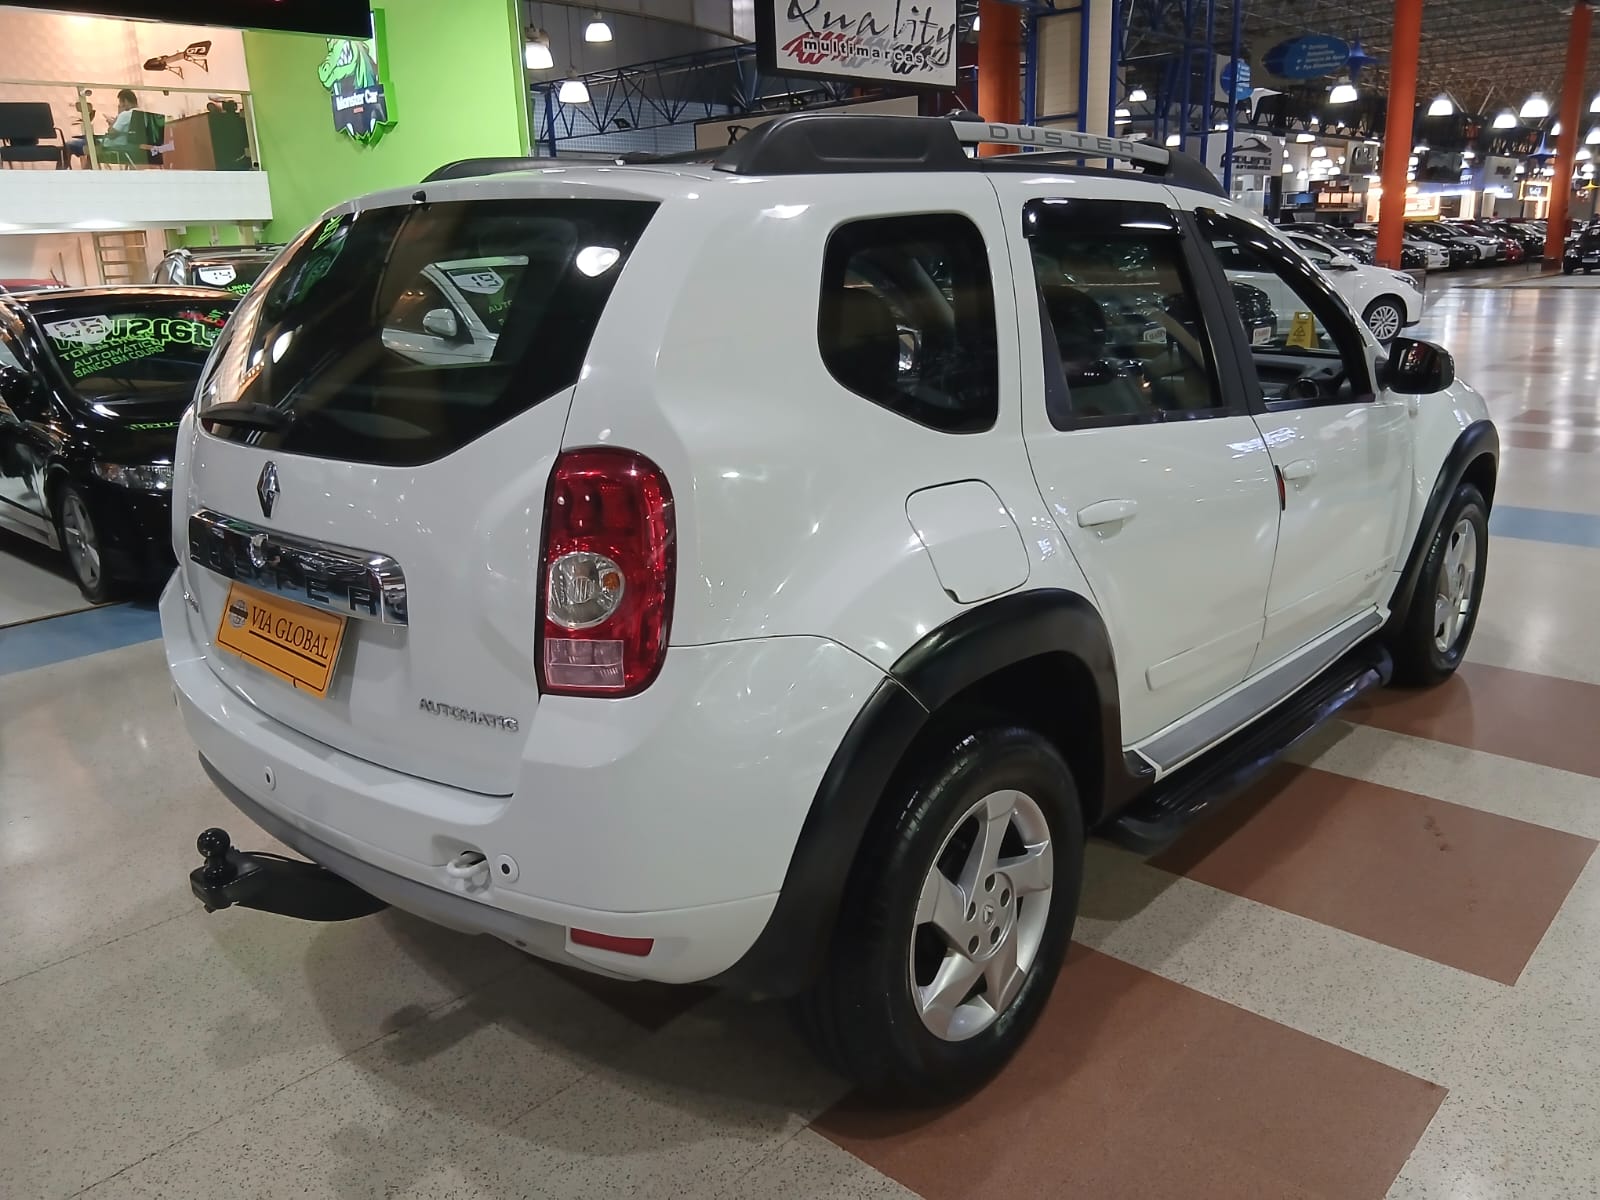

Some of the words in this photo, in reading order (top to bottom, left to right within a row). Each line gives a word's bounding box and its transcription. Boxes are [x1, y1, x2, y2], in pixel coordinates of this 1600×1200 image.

[787, 0, 956, 67] Quality
[803, 38, 924, 64] multimarcas
[336, 92, 365, 111] Monster
[365, 89, 378, 104] Car
[989, 124, 1135, 153] DUSTER
[72, 360, 112, 378] BANCO
[112, 354, 129, 366] EM
[129, 345, 165, 360] COURO
[252, 606, 272, 634] VIA
[275, 617, 328, 660] GLOBAL
[419, 697, 520, 734] AUTOMATIC
